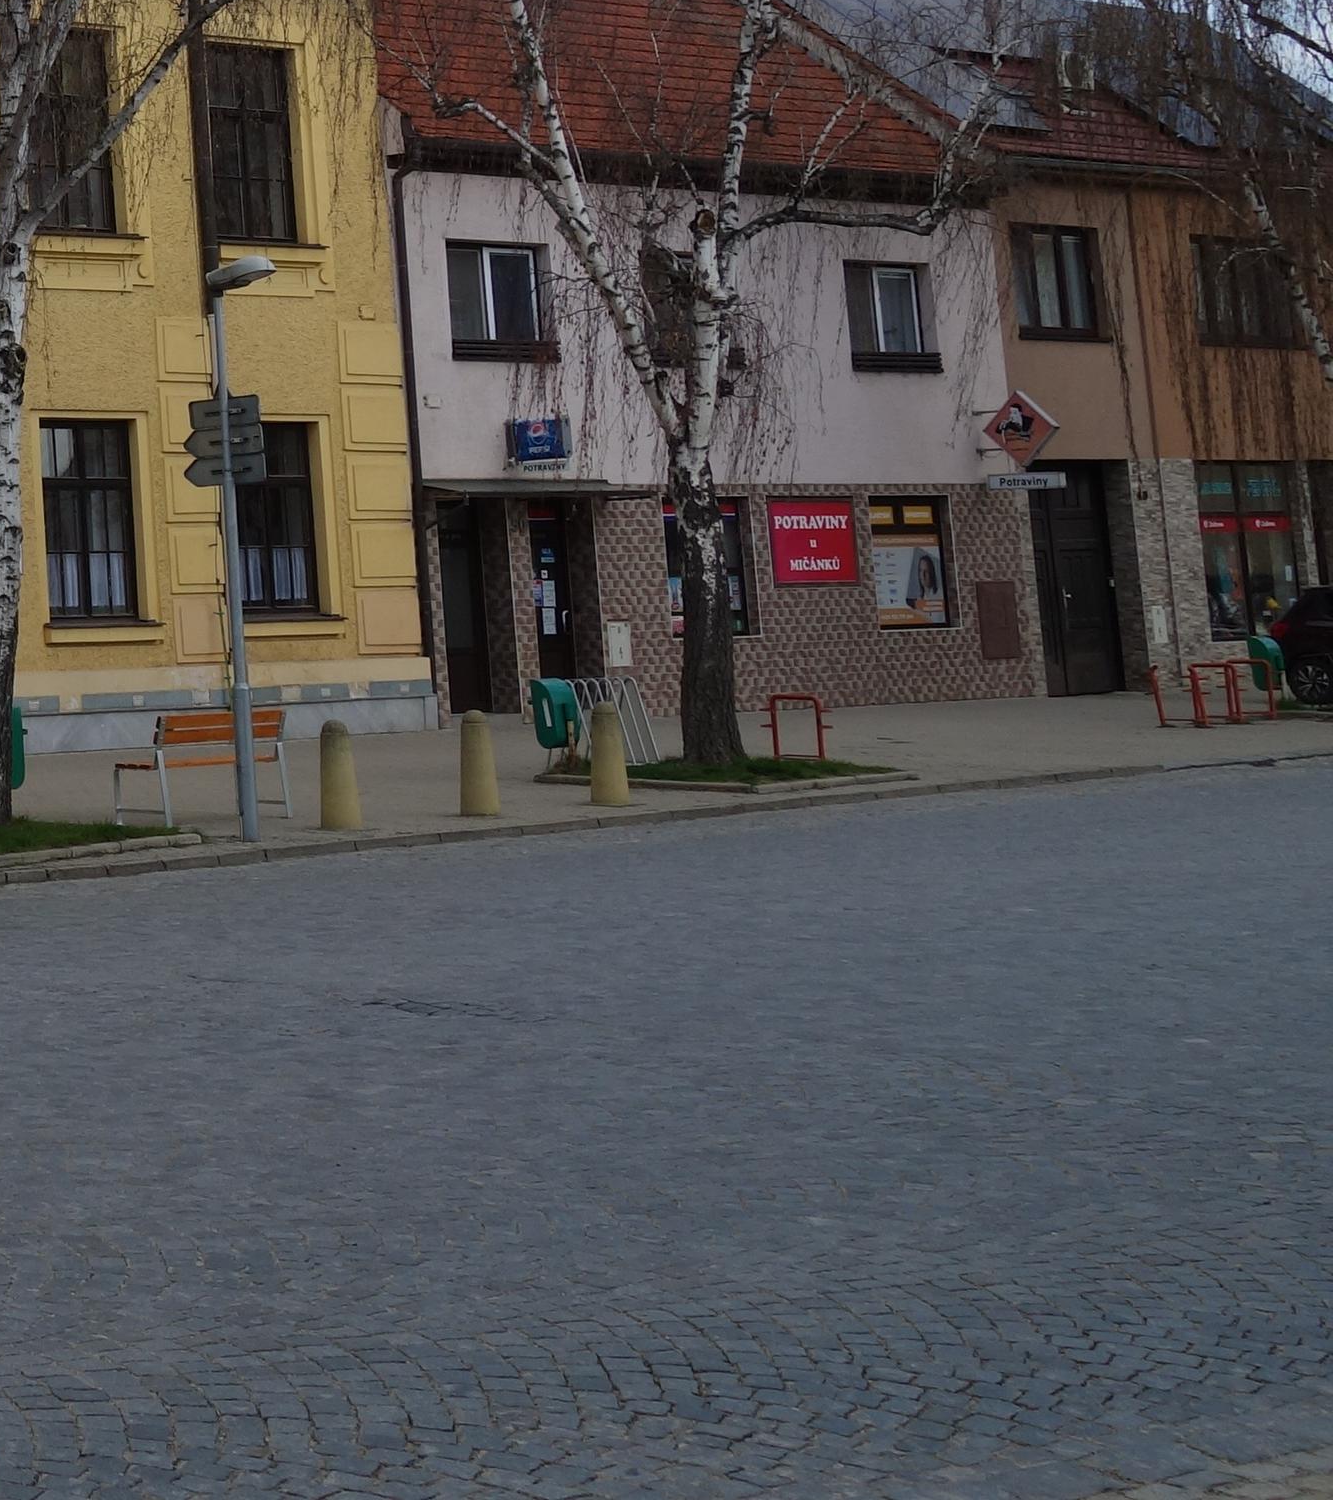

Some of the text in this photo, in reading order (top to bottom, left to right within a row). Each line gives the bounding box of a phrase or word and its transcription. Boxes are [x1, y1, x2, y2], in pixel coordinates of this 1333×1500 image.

[999, 476, 1049, 487] Potraviny
[773, 515, 849, 530] POTRAVINY
[809, 539, 818, 548] u
[790, 555, 840, 571] MIČÁNKŮ
